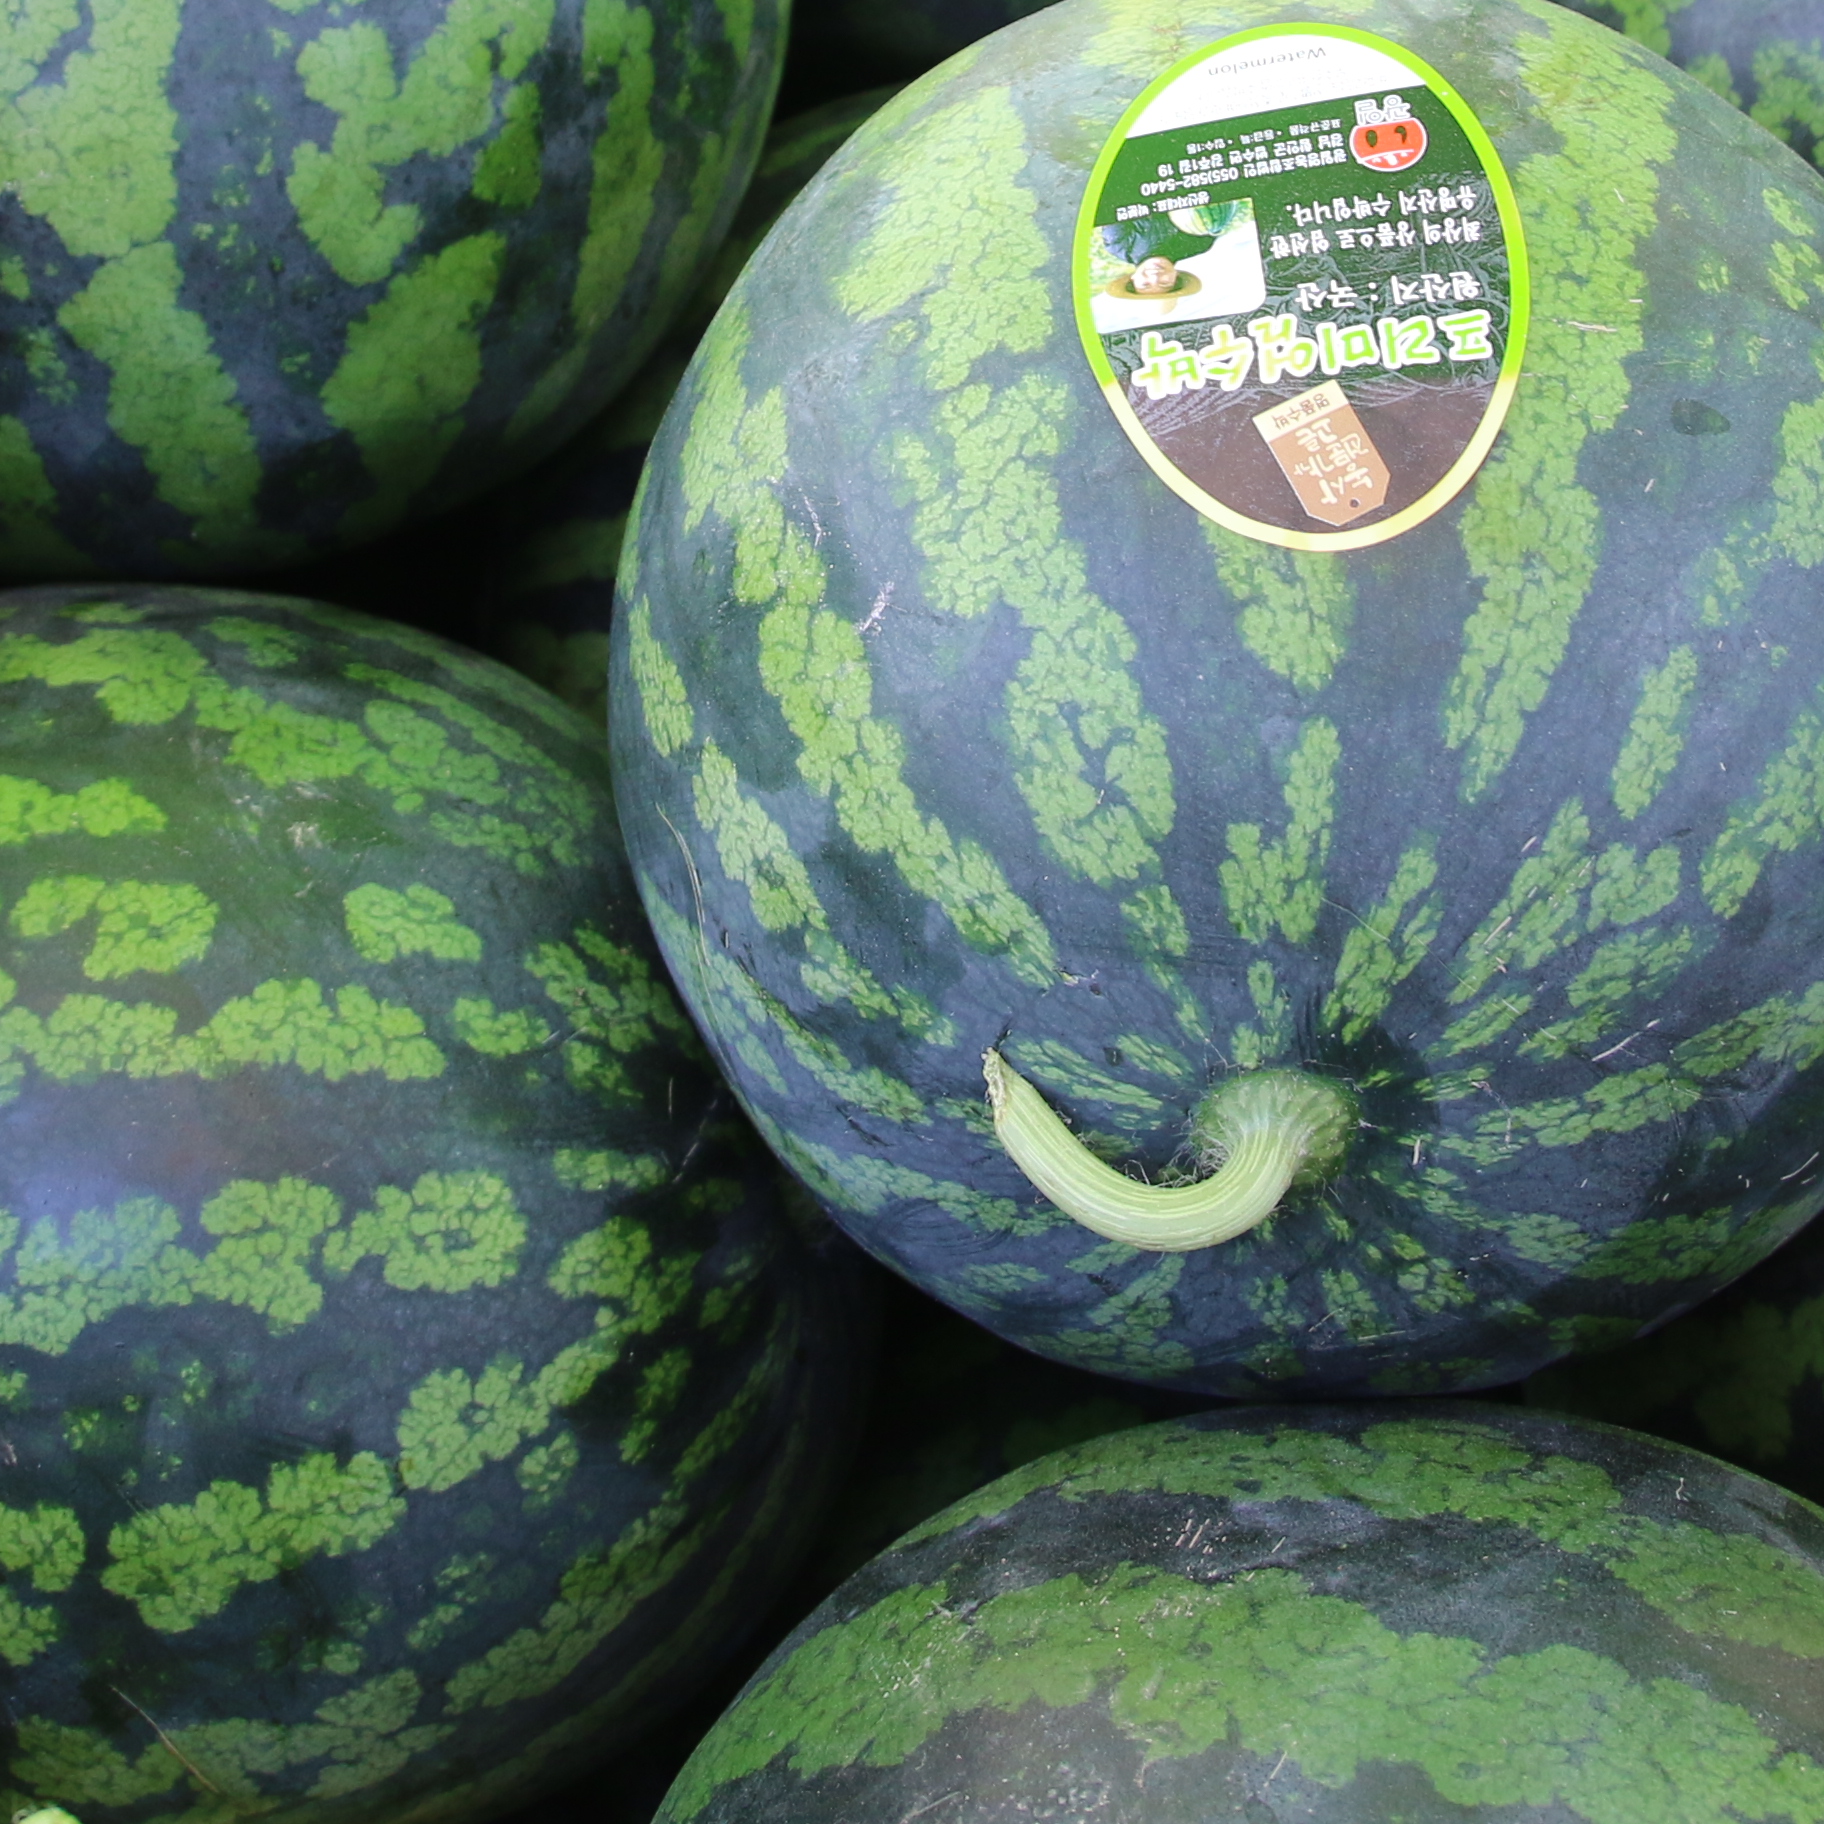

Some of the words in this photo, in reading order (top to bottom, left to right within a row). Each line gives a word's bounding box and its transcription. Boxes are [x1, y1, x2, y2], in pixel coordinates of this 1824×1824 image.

[1208, 47, 1327, 78] Watermelon
[1355, 96, 1412, 127] 광일
[1229, 146, 1268, 165] 법수면
[1273, 138, 1312, 157] 함안군
[1318, 133, 1343, 150] 경남
[1158, 164, 1174, 177] 19
[1179, 154, 1223, 175] 강주1길
[1244, 149, 1346, 178] 광일영농조합법인
[1141, 167, 1238, 196] 055)582-5440
[1286, 193, 1391, 226] 수박입니다.
[1399, 185, 1478, 215] 유명산지
[1269, 229, 1330, 259] 엄선한
[1335, 222, 1416, 250] 상품으로
[1422, 217, 1483, 246] 최상의
[1294, 282, 1358, 313] 국산
[1390, 272, 1483, 307] 원산지
[1132, 311, 1495, 400] 프리미엄수박
[1272, 392, 1331, 431] 명품수박
[1296, 417, 1334, 450] 고른
[1321, 461, 1373, 505] 농사
